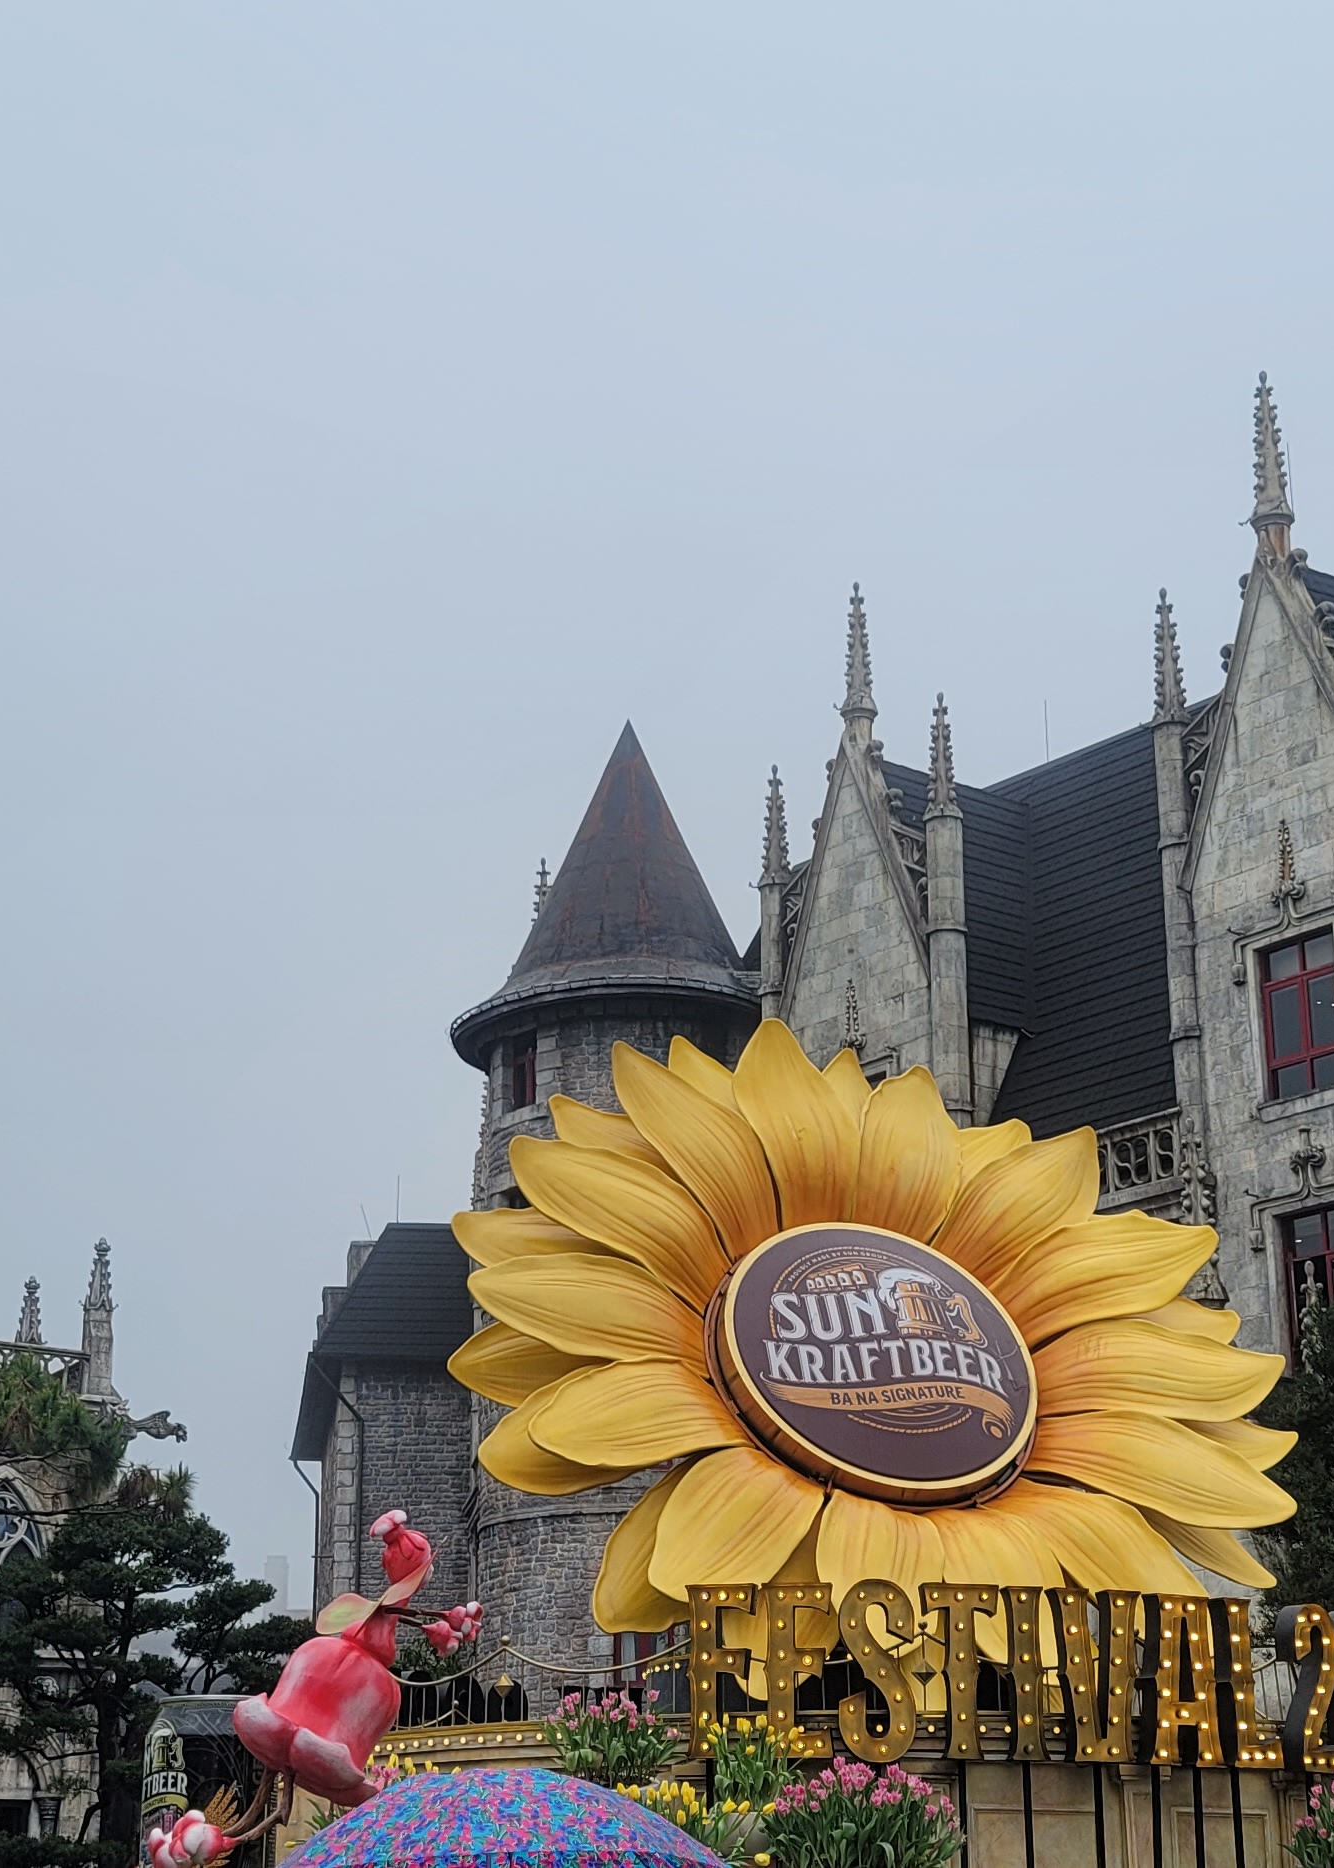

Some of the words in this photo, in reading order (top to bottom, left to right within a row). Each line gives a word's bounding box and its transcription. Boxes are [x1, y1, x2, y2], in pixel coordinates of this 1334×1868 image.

[770, 1287, 891, 1341] SUN
[762, 1337, 1010, 1398] KRAFTBEER
[830, 1391, 854, 1407] BA
[855, 1390, 880, 1406] NA
[880, 1384, 966, 1404] SIGNATURE
[685, 1578, 1285, 1769] FESTIVAL
